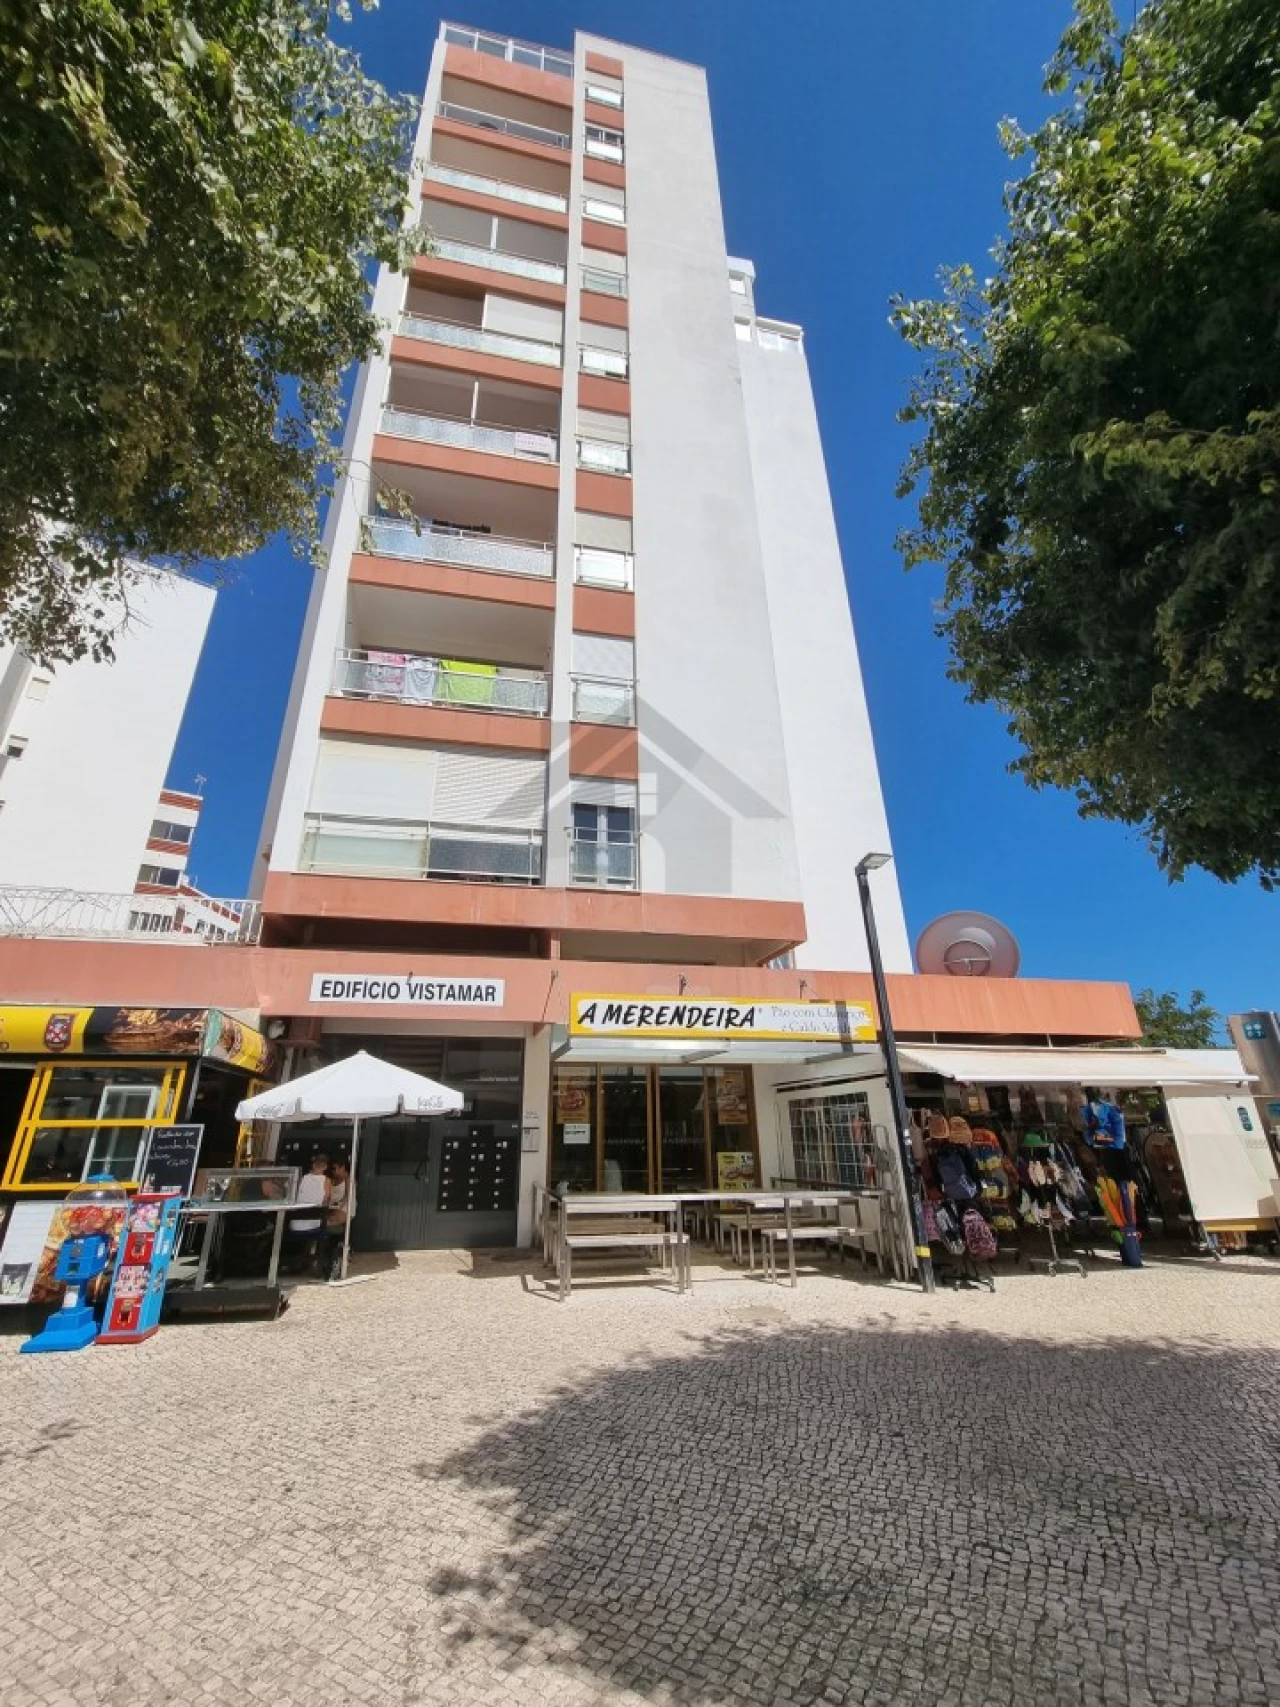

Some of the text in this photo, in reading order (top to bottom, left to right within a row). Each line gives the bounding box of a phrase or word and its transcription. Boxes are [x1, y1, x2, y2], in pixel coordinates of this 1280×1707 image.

[320, 978, 497, 1002] EDIFÍCIO VISTAMAR
[577, 1002, 755, 1030] A MERENDEIRA
[793, 1009, 815, 1018] com
